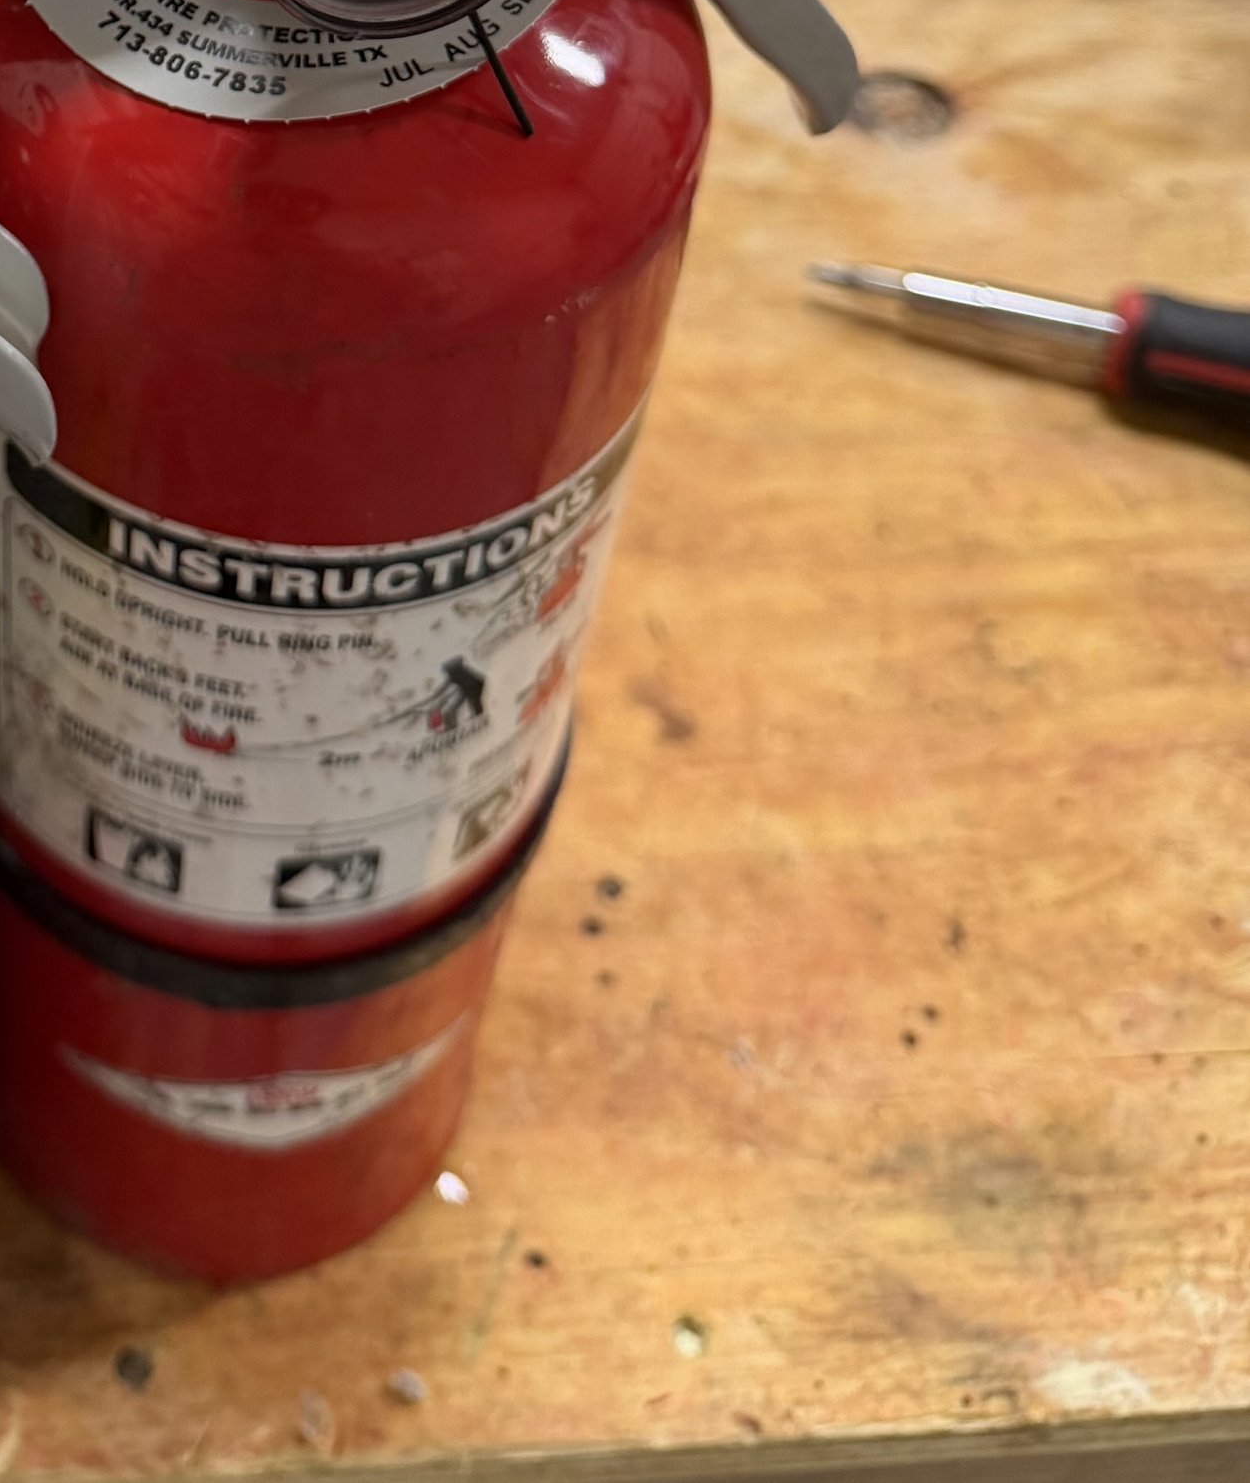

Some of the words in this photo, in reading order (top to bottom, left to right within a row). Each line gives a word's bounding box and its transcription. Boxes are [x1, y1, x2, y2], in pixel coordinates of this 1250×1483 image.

[97, 11, 287, 96] 713-806-7835
[177, 29, 348, 69] SUMMERVILLE
[353, 44, 388, 63] TX
[380, 58, 435, 88] JUL
[443, 18, 501, 62] AUG
[107, 474, 596, 609] INSTRUCTIONS
[216, 623, 271, 648] PULL
[277, 631, 331, 651] RING
